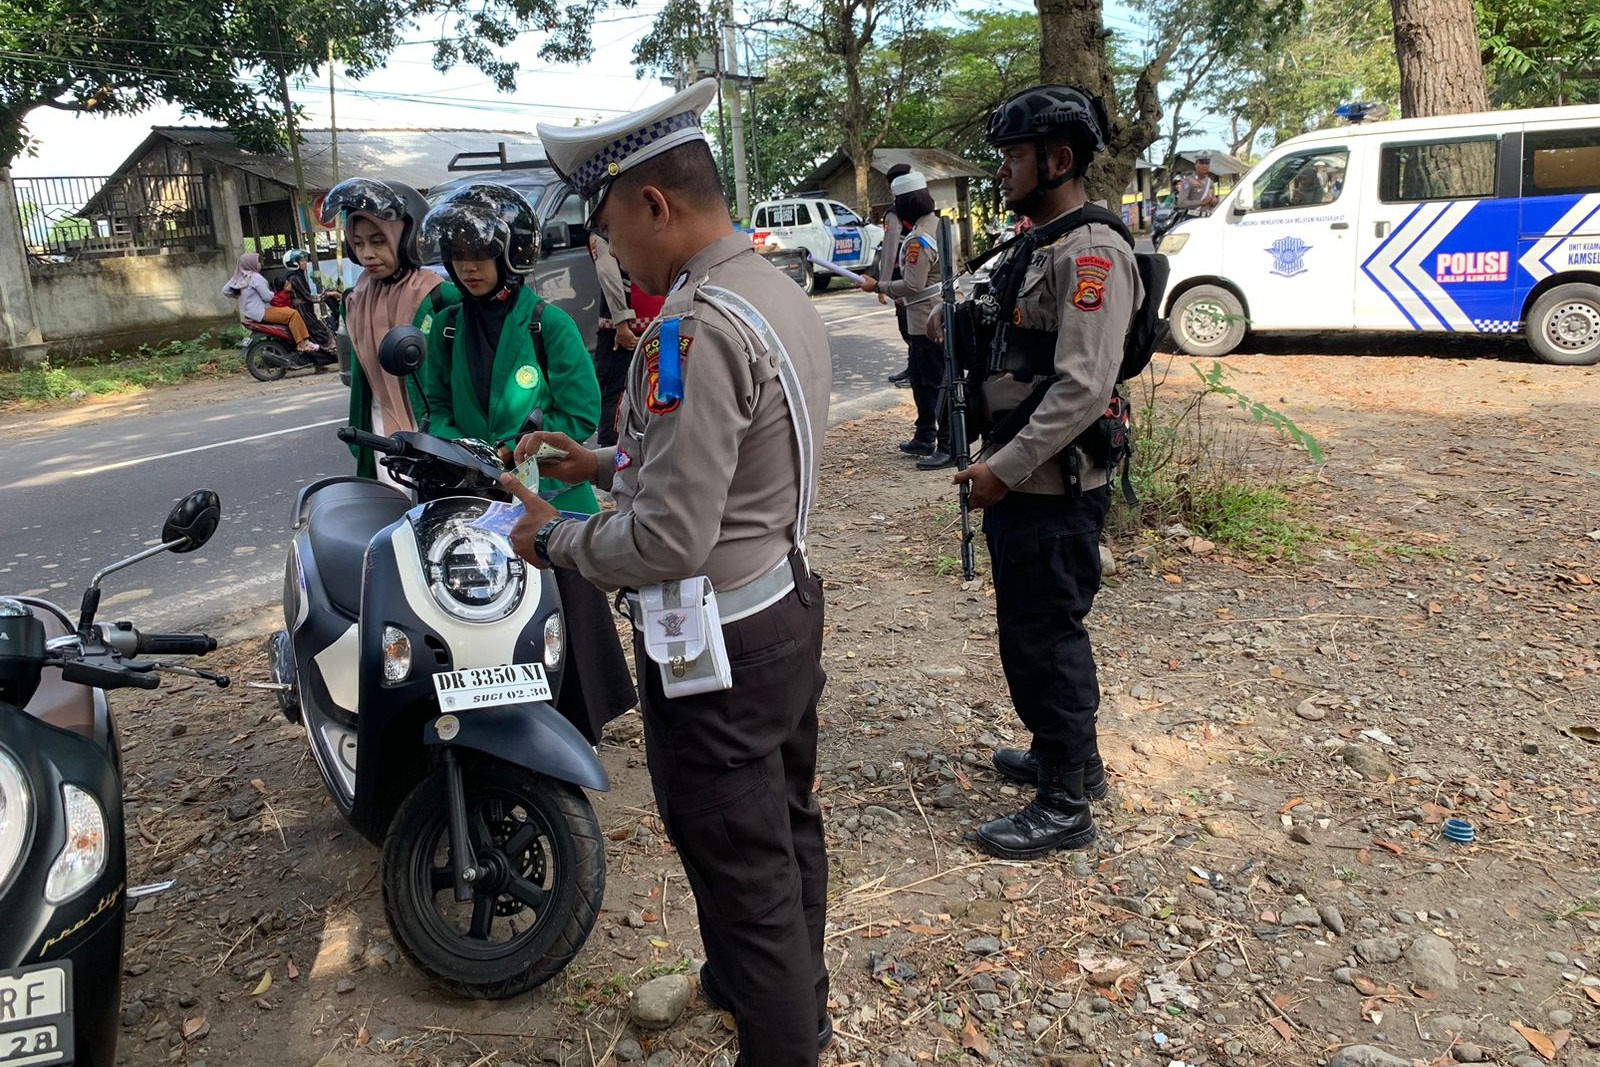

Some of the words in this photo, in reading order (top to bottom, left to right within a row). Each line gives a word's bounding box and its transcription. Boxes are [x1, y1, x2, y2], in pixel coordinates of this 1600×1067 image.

[1568, 243, 1582, 251] UNIT
[1437, 251, 1508, 275] POLISI
[1437, 274, 1465, 283] LALU
[1465, 273, 1508, 282] LINTAS
[439, 672, 466, 690] DR
[470, 667, 516, 686] 3350
[520, 664, 543, 681] NI
[473, 692, 503, 703] SUCI
[506, 687, 548, 699] 02.30
